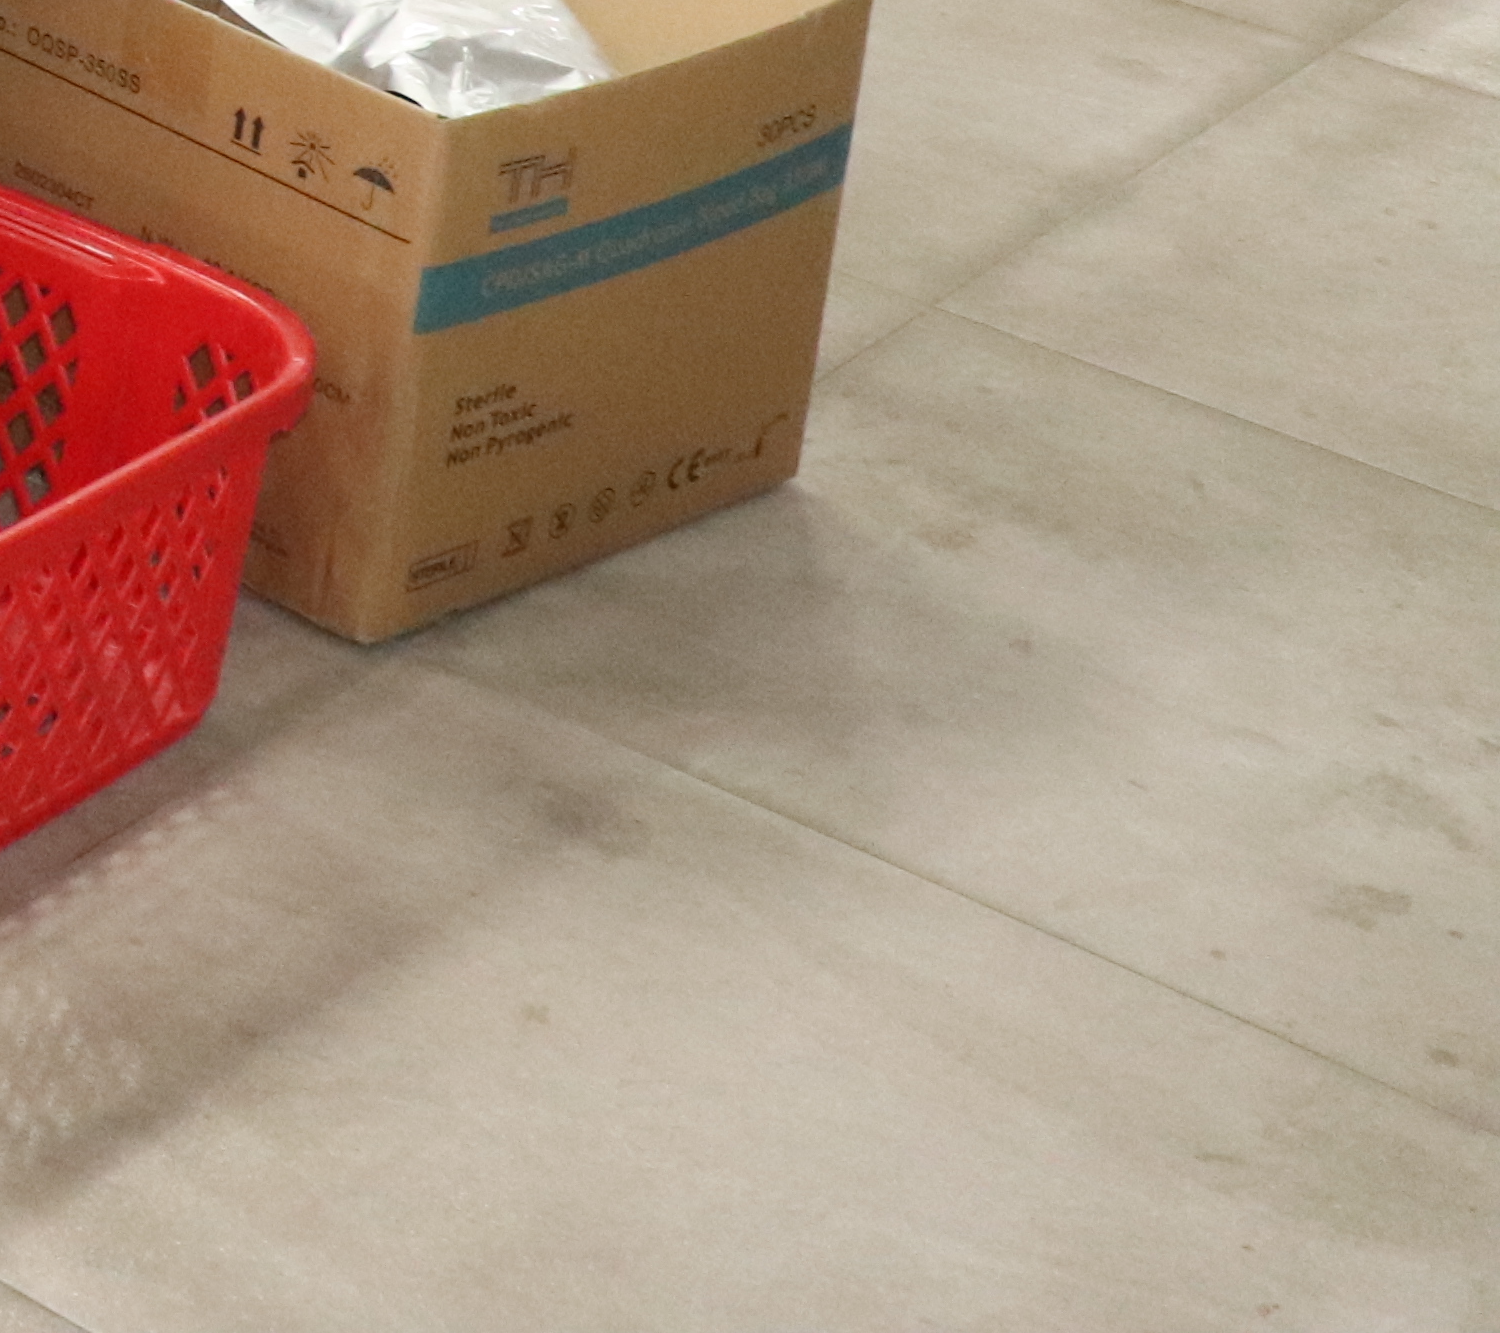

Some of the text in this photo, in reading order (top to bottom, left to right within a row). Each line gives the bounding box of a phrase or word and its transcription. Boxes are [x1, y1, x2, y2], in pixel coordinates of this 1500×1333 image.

[454, 383, 517, 415] Sterile
[446, 412, 576, 469] Non Pyrogenic
[449, 401, 537, 443] Non Toxic
